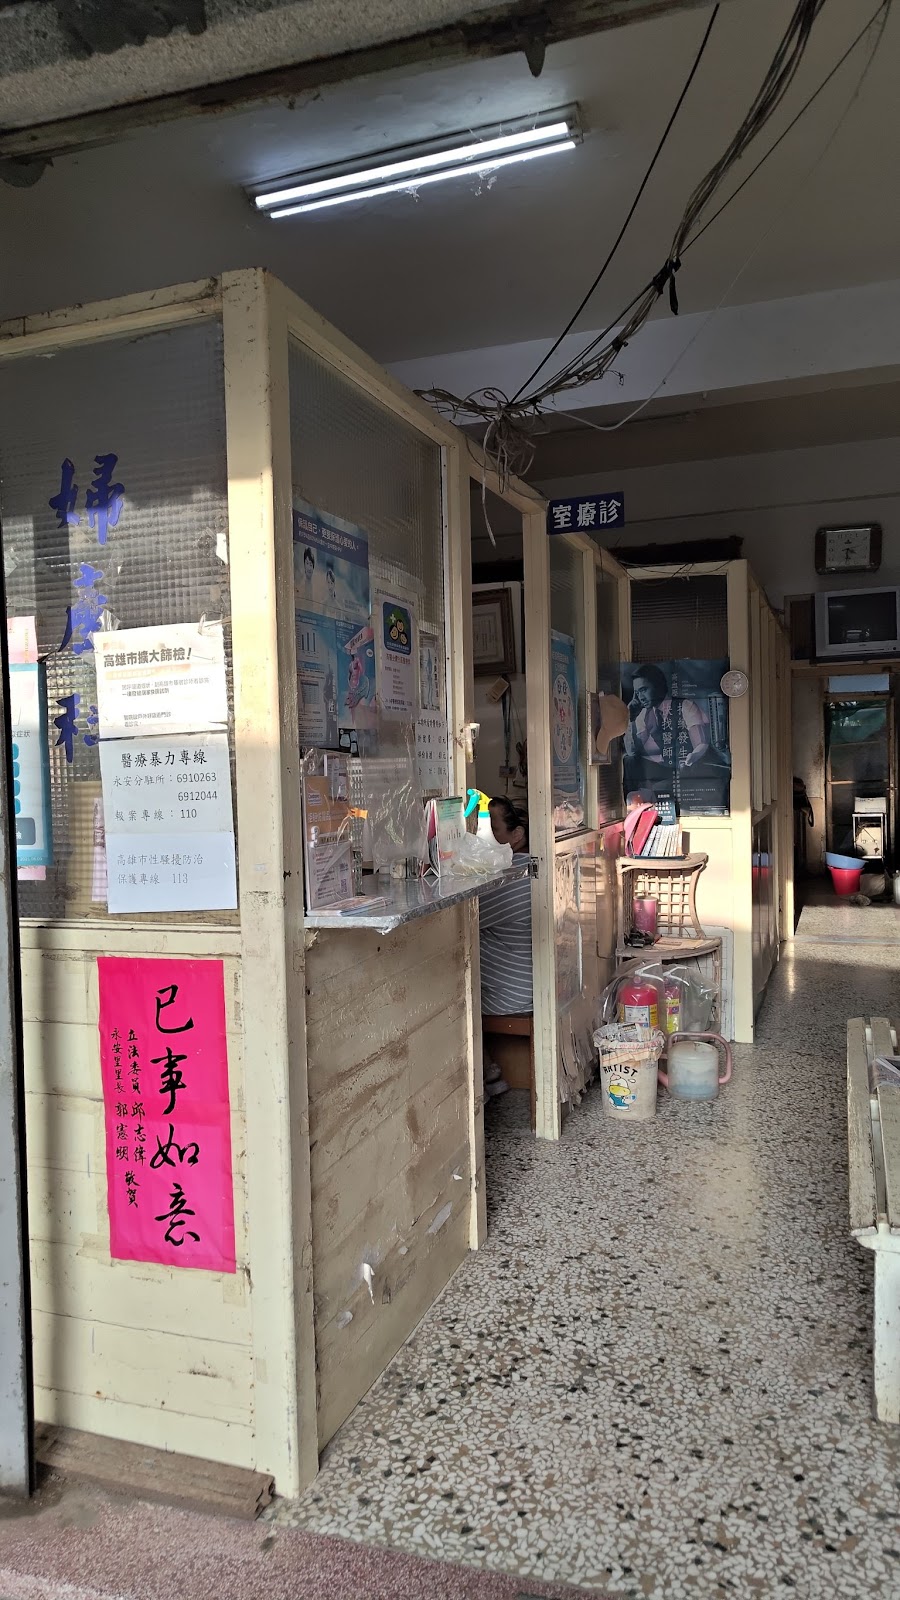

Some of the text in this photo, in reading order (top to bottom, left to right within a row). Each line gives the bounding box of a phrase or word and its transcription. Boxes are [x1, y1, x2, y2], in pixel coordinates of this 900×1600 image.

[120, 749, 208, 768] 醫療暴力專線
[177, 790, 218, 802] 6912044
[116, 854, 204, 867] 高雄市性騷擾防治
[117, 873, 188, 885] 保護專線 113
[602, 1064, 638, 1077] ARTIST
[110, 1027, 130, 1163] 永安里里長 郭憲明
[127, 1028, 147, 1167] 立法委員 邱志偉
[124, 1170, 141, 1209] 敬賀
